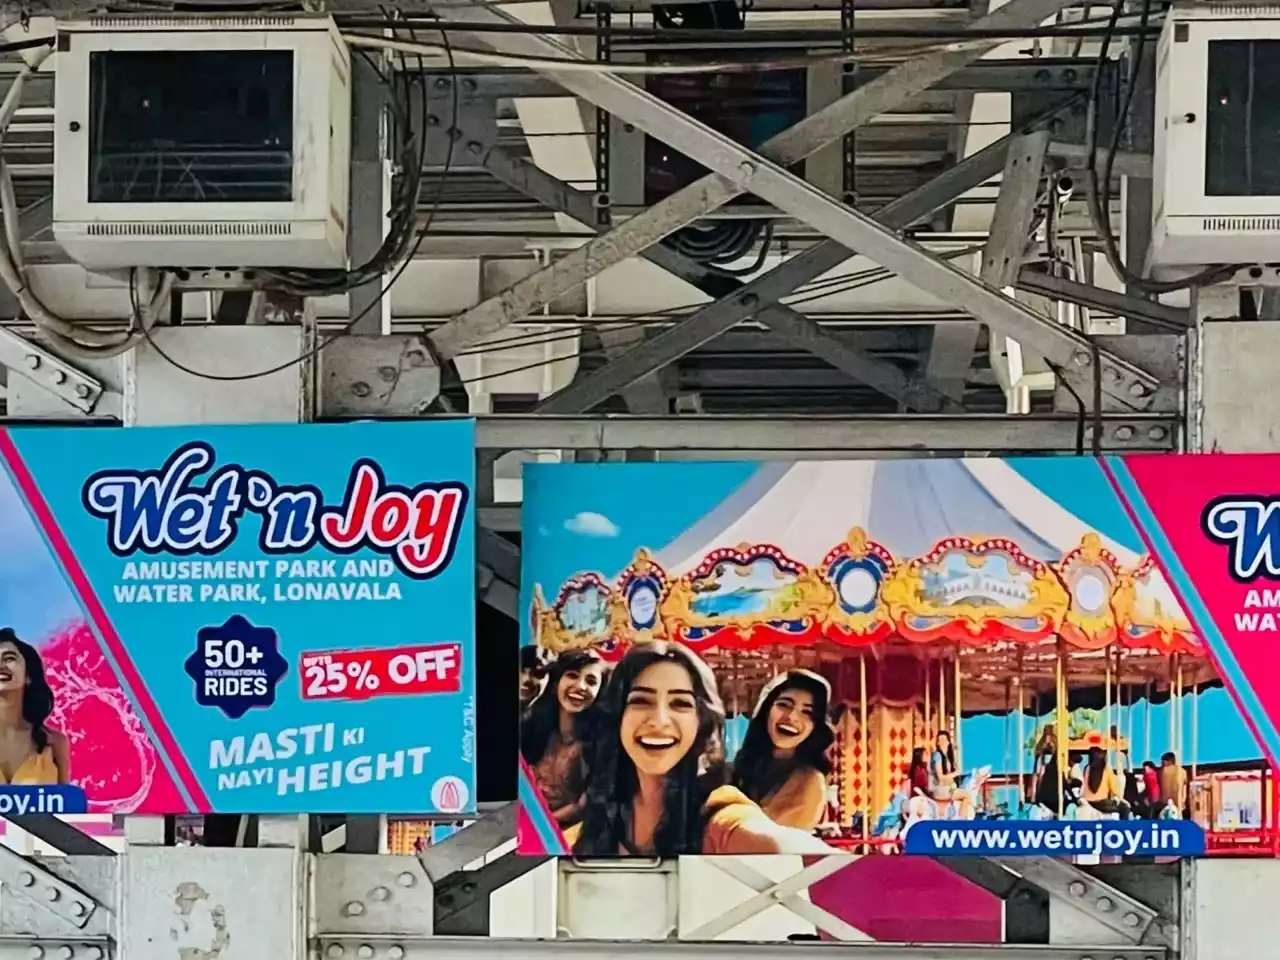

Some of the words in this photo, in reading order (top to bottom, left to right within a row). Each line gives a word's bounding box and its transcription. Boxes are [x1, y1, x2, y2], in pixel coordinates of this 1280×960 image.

[88, 448, 241, 550] Wet
[321, 463, 462, 573] Joy
[122, 561, 269, 580] AMUSEMENT
[275, 560, 338, 578] PARK
[342, 560, 393, 578] AND
[114, 585, 193, 603] WATER
[200, 584, 266, 605] PARK,
[273, 582, 401, 601] LONAVALA
[204, 640, 263, 668] 50+
[204, 677, 267, 696] RIDES
[305, 660, 380, 696] 25%
[209, 722, 334, 769] MASTI
[343, 727, 364, 746] KI
[218, 767, 273, 791] NAYI
[277, 747, 431, 796] HEIGHT
[931, 824, 1179, 855] www.wetnjoy.in
